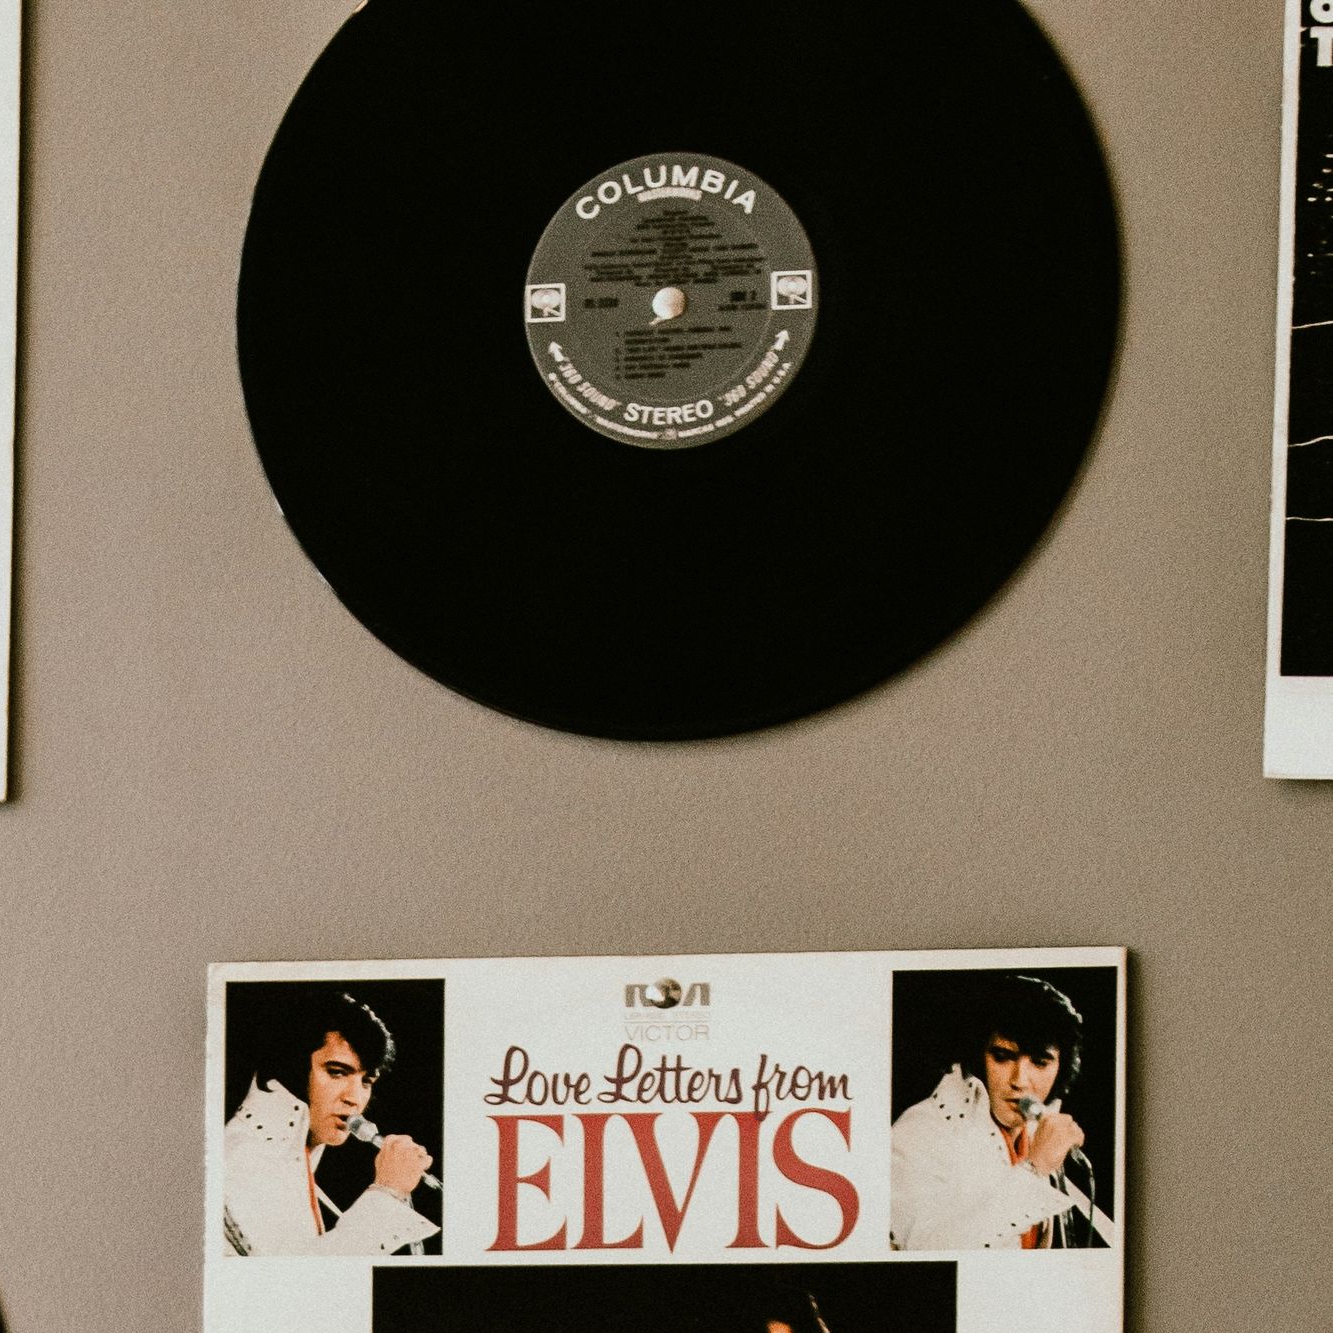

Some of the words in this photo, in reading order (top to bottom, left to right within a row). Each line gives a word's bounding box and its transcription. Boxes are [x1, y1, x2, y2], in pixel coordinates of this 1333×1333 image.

[575, 164, 757, 219] COLUMBIA
[623, 399, 714, 426] STEREO
[624, 1024, 710, 1041] VICTOR
[484, 1045, 592, 1105] Love
[598, 1043, 743, 1105] Letters
[751, 1054, 854, 1122] from
[484, 1107, 860, 1254] ELVIS
